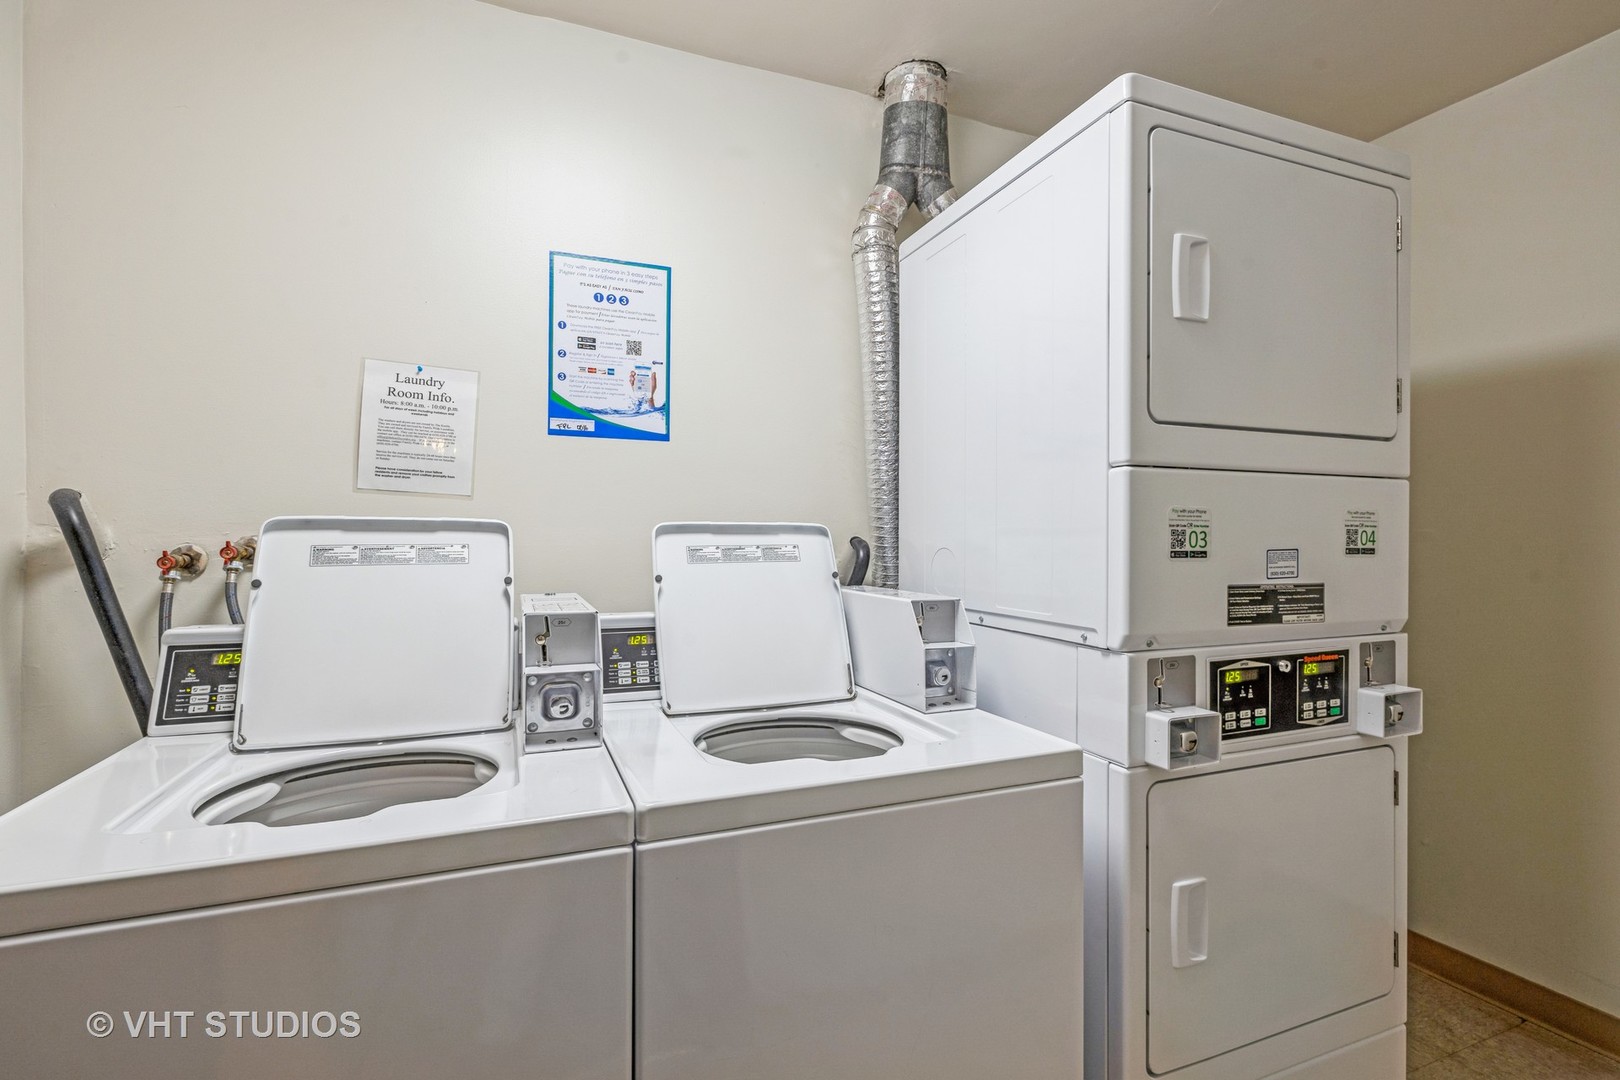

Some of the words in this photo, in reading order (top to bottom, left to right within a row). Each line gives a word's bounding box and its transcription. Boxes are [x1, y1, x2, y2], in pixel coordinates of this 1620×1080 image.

[395, 372, 446, 390] Laundry
[380, 398, 398, 406] Hours:
[387, 386, 424, 400] Room
[428, 391, 455, 404] Info.
[1188, 530, 1208, 549] 03
[1360, 529, 1376, 546] 04
[1304, 655, 1321, 663] Speed
